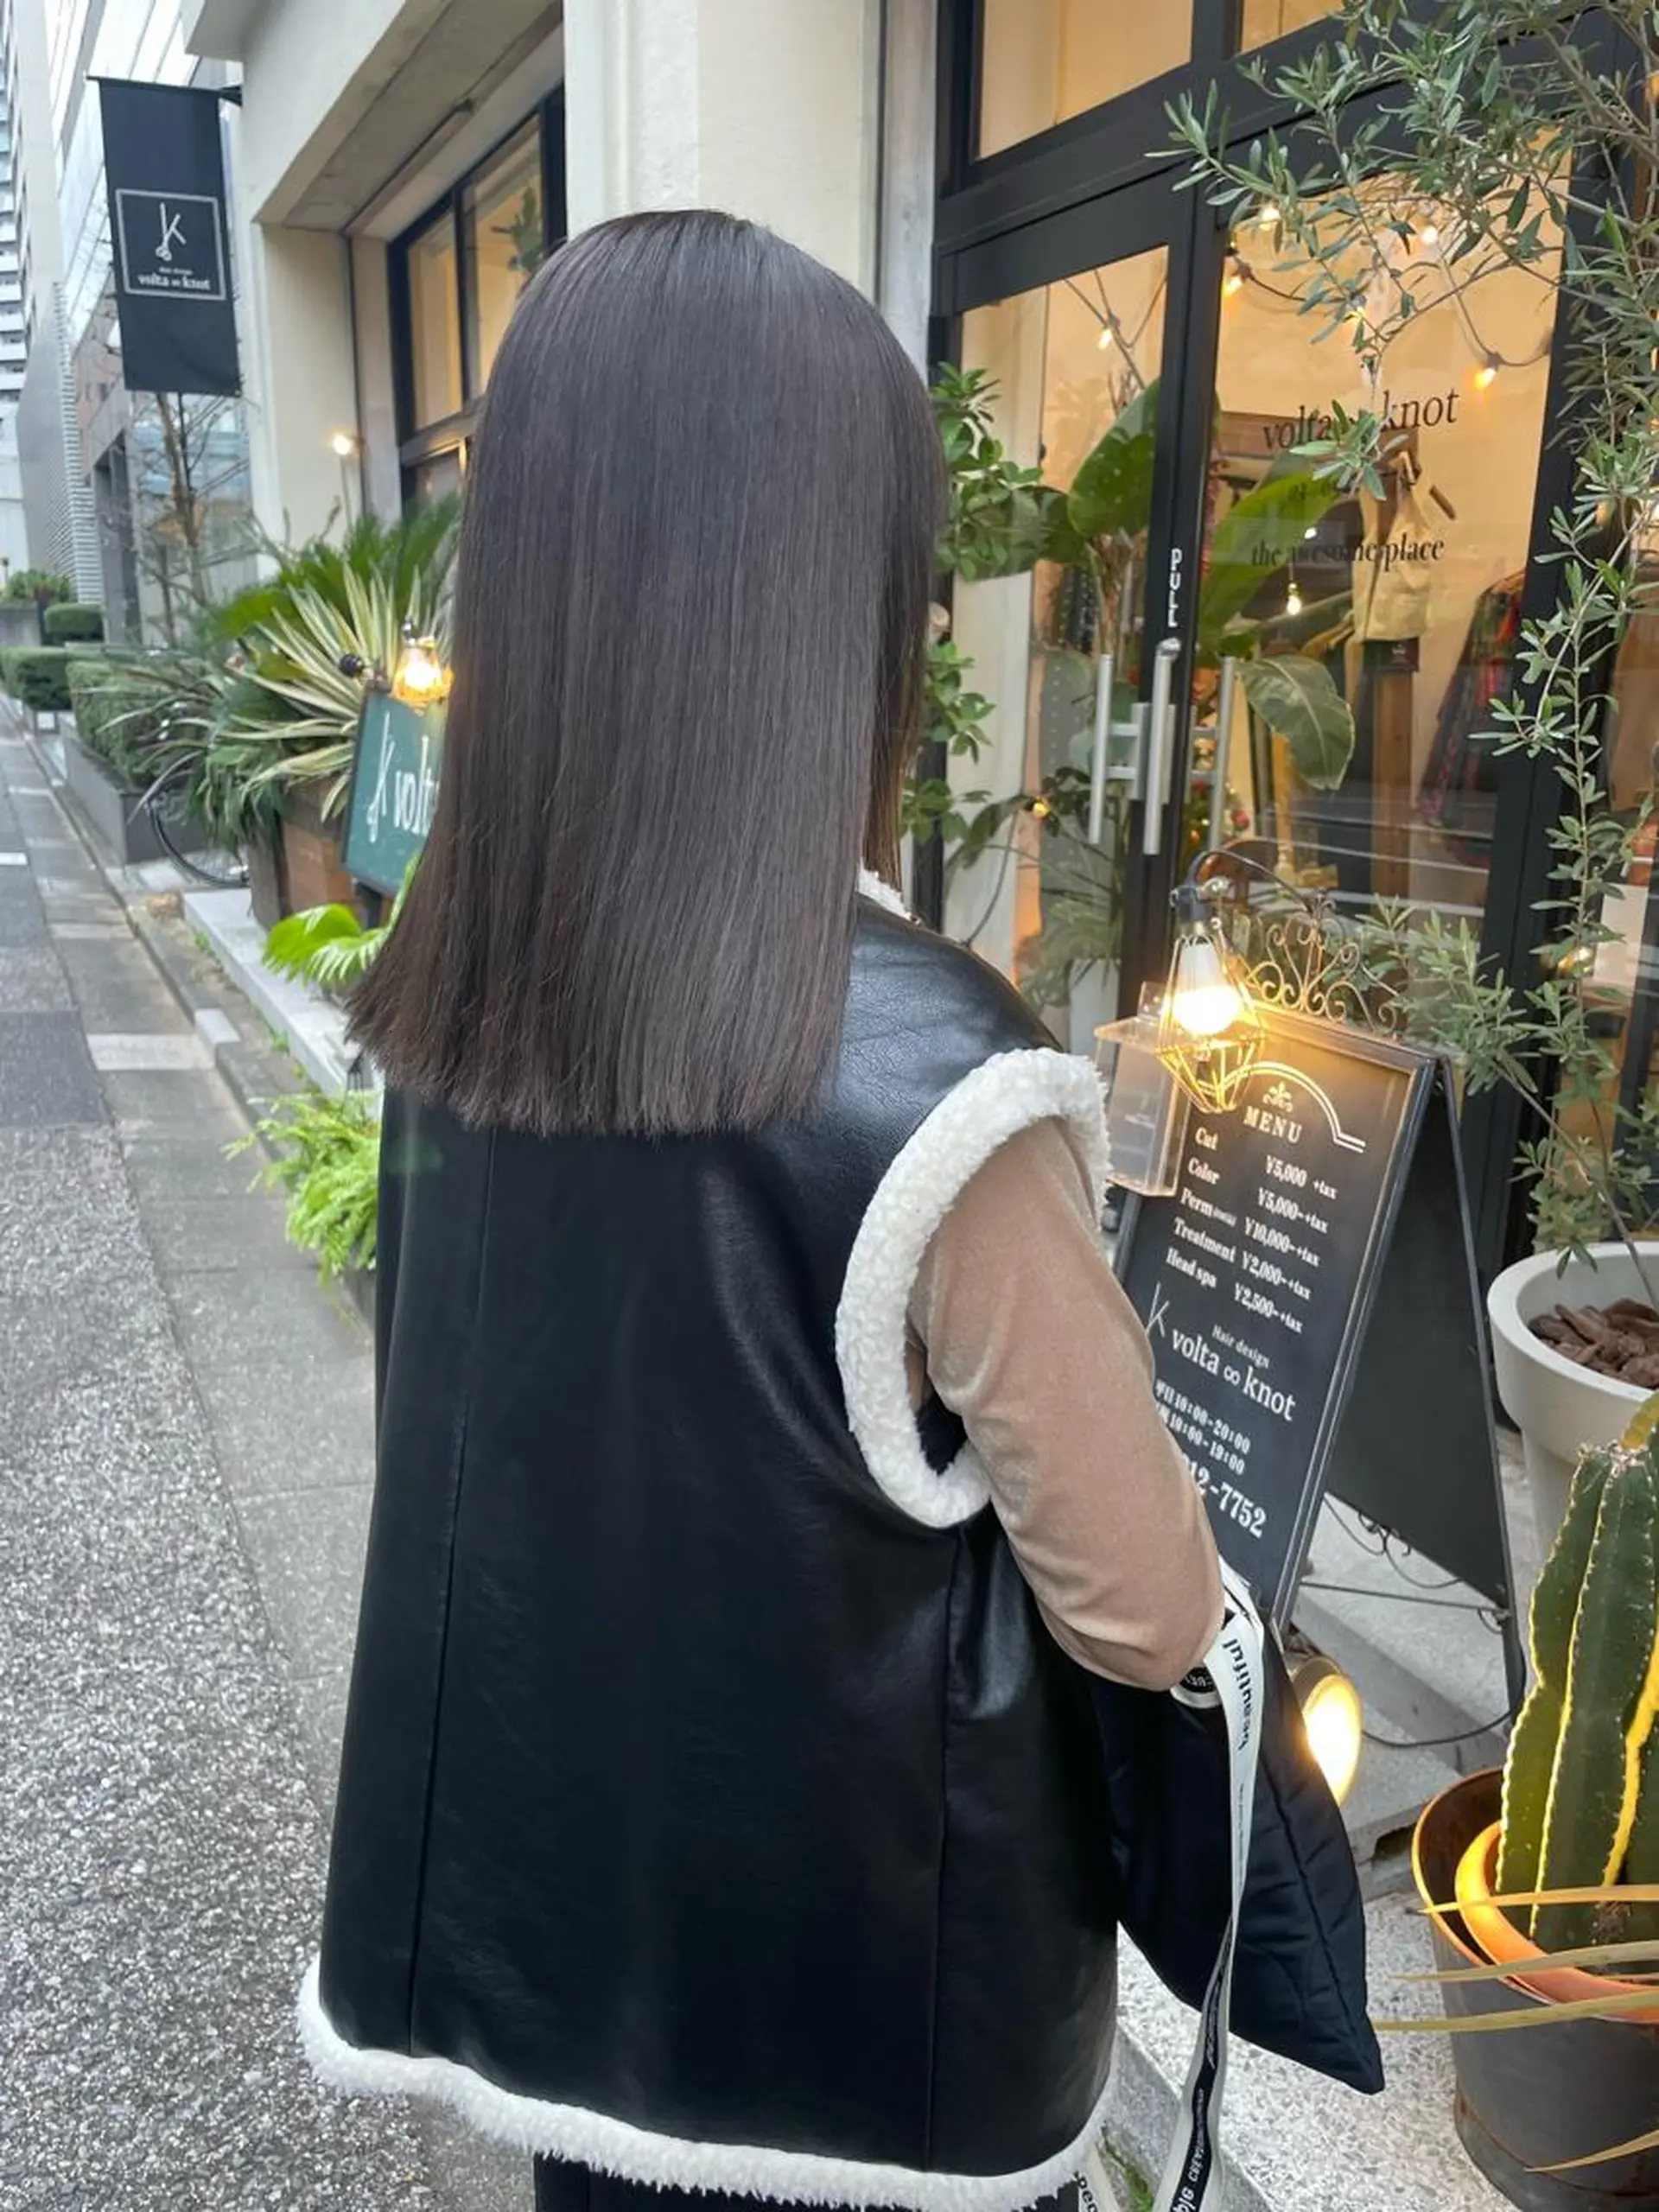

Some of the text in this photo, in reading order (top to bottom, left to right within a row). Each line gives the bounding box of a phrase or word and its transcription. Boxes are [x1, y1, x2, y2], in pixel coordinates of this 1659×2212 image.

[1382, 532, 1445, 572] place
[1168, 548, 1183, 627] PULL
[1195, 1126, 1219, 1150] Cut
[1243, 1105, 1303, 1144] MENU
[1188, 1157, 1220, 1185] Color
[1180, 1187, 1213, 1217] Perm
[1173, 1217, 1236, 1263] Treatment
[1166, 1246, 1218, 1289] Head spa
[1211, 1324, 1270, 1369] Hair design
[1172, 1328, 1220, 1376] volta
[1242, 1365, 1296, 1421] knot
